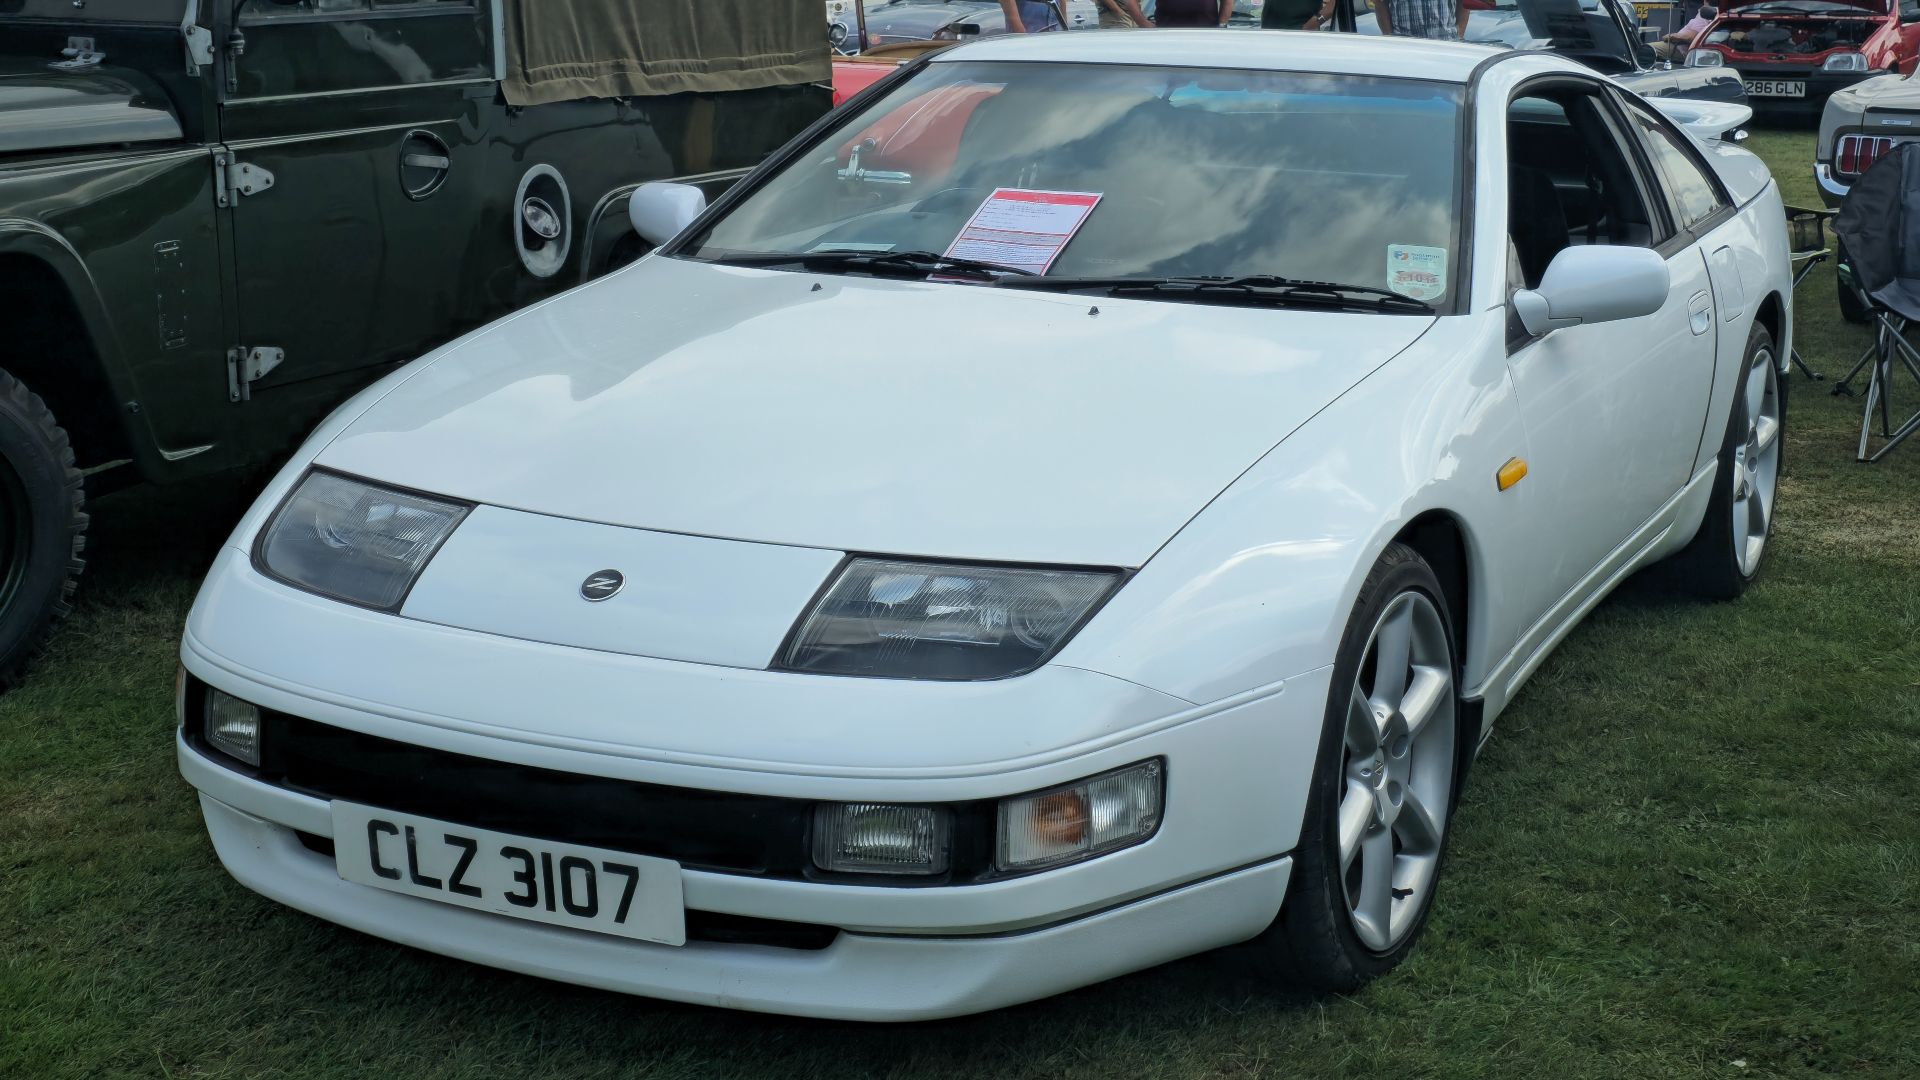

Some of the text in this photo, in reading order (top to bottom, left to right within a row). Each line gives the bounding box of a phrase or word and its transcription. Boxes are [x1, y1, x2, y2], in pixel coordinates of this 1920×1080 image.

[1775, 82, 1803, 95] GLN
[367, 818, 640, 924] CLZ 3107
